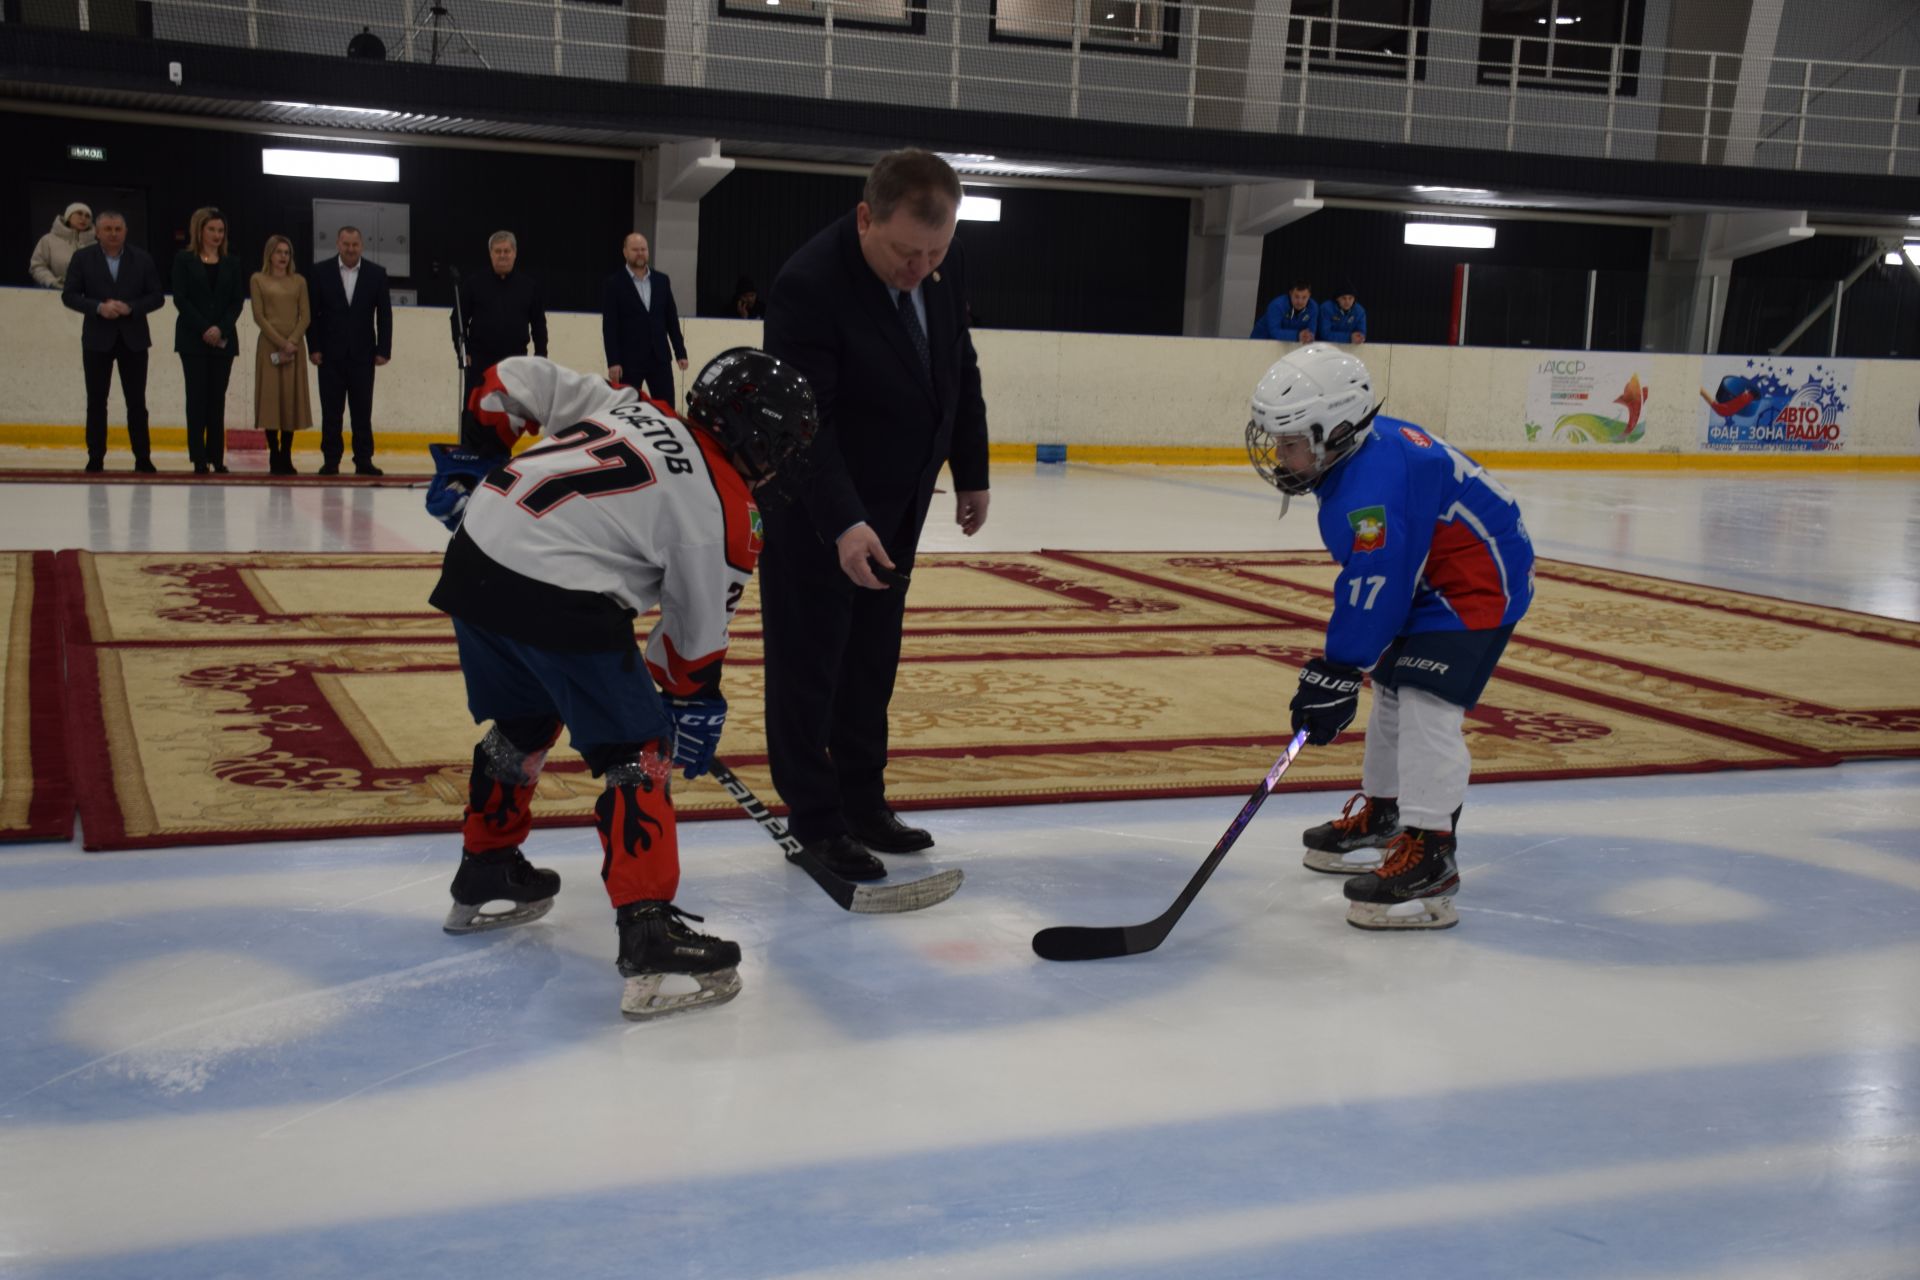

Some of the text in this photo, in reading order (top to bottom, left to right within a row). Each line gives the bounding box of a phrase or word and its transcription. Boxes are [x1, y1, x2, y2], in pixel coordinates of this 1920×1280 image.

[1776, 406, 1819, 423] АВТО
[609, 404, 694, 475] САЕТОВ
[1710, 426, 1739, 440] ФАН
[1748, 426, 1784, 440] ЗОНА
[1785, 424, 1840, 440] РАДИО
[481, 418, 657, 519] 27
[1348, 575, 1387, 610] 17
